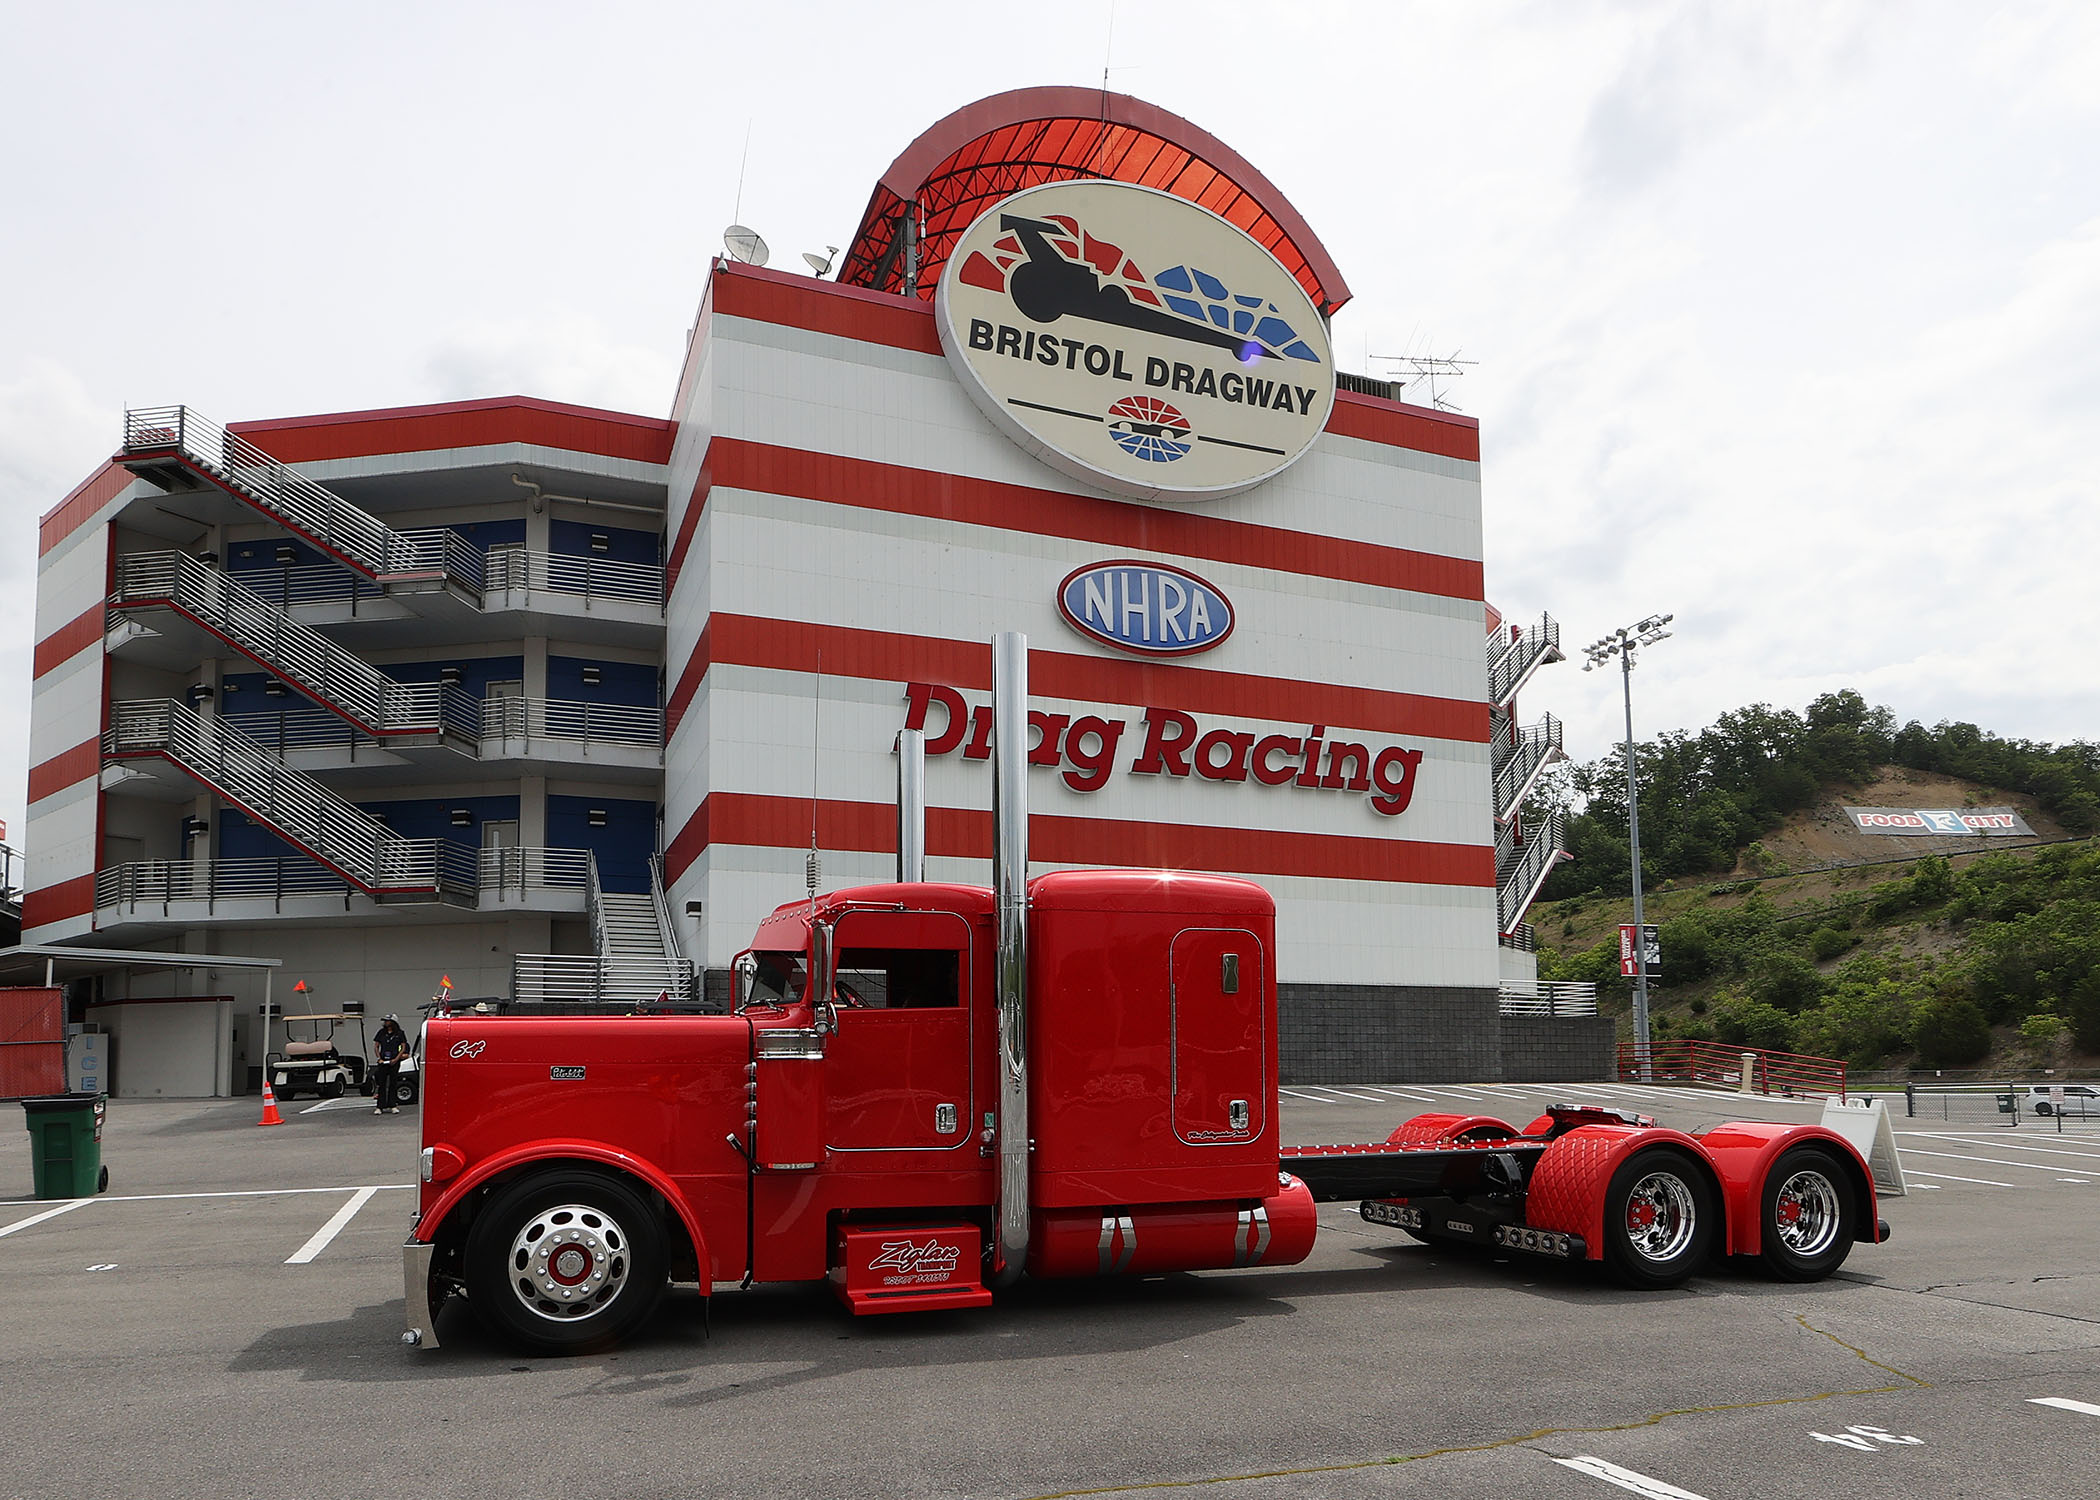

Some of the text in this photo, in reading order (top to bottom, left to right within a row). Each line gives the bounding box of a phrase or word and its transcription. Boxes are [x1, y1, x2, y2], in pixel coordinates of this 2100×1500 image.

[968, 318, 1317, 417] BRISTOL DRAGWAY
[1084, 571, 1213, 642] NHRA
[1130, 707, 1424, 817] Racing
[1857, 813, 2014, 828] FOOD CITY
[82, 1036, 98, 1091] ICE
